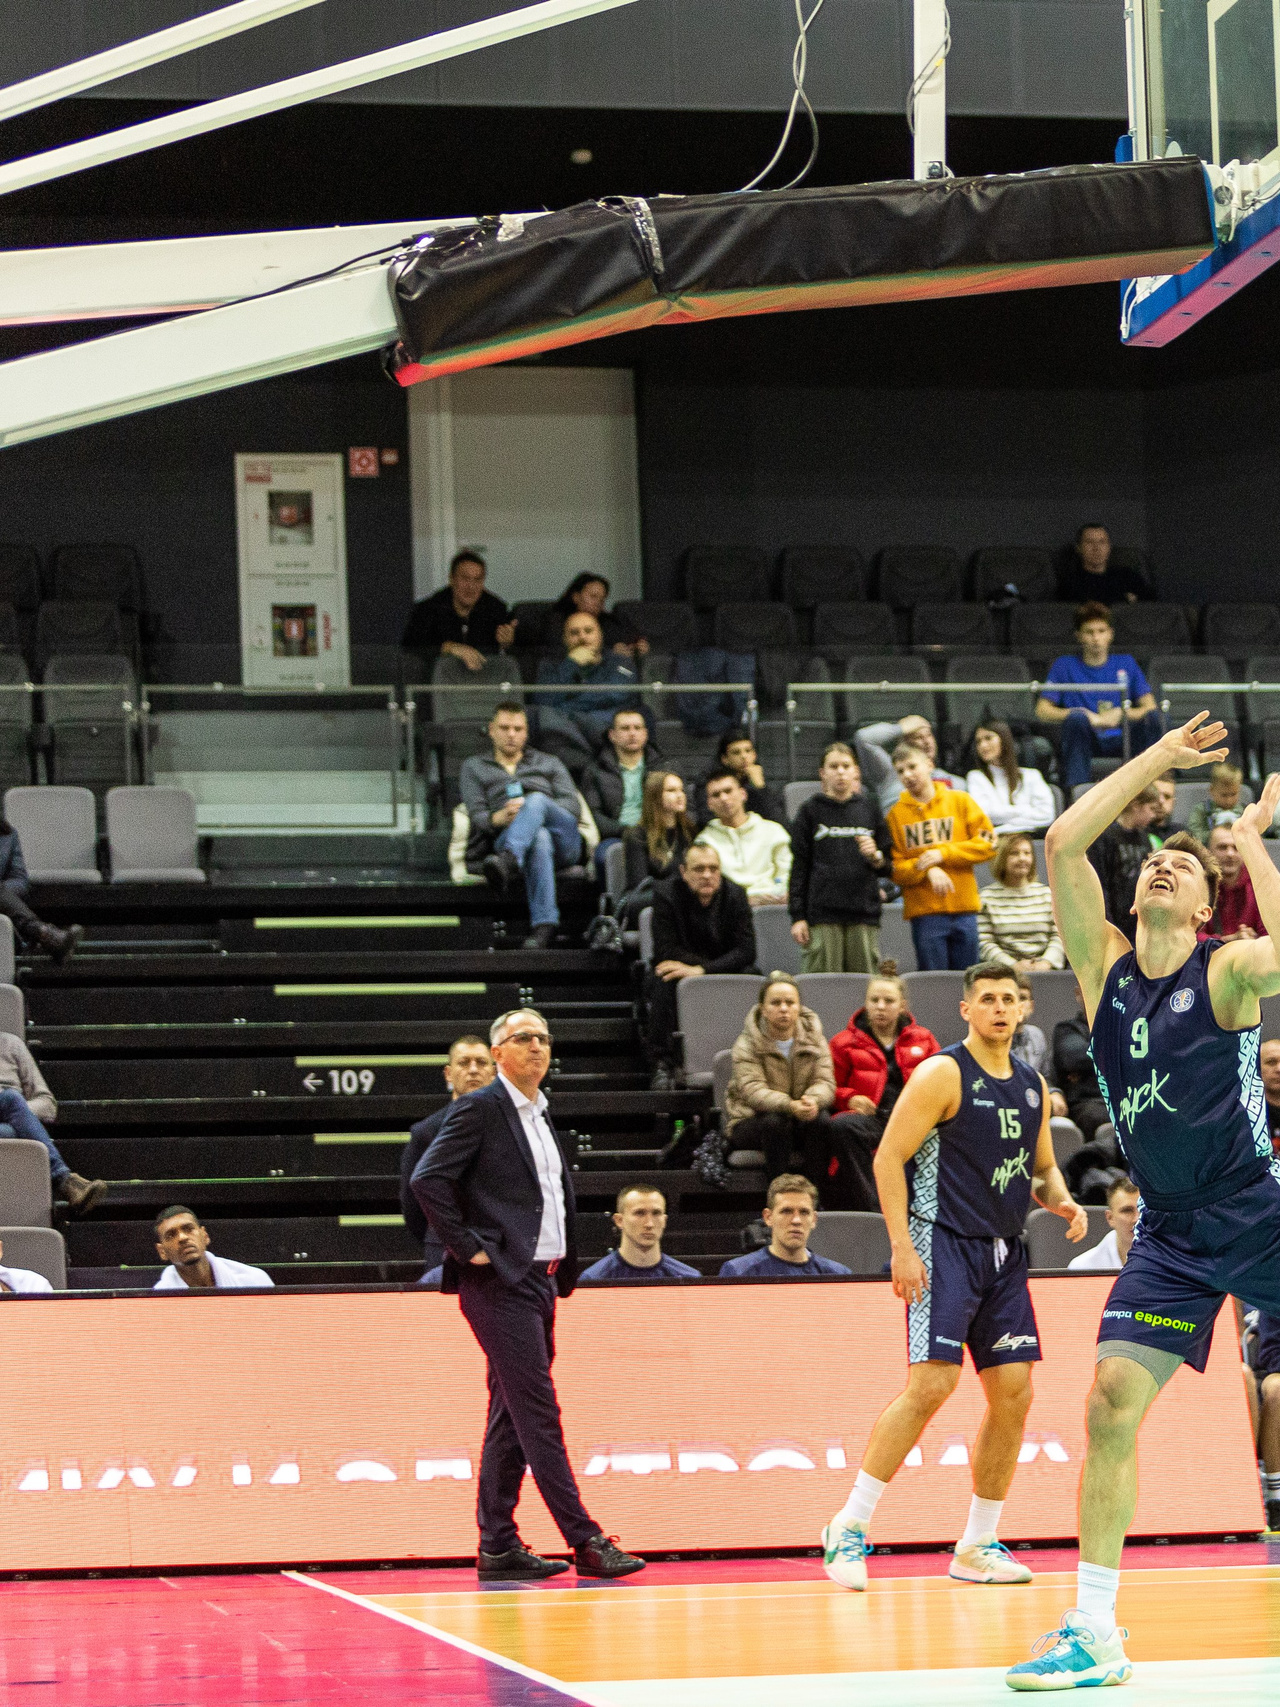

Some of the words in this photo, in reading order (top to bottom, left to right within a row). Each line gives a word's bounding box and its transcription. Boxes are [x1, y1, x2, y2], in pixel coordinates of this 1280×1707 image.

[904, 817, 954, 849] NEW
[1130, 1017, 1149, 1059] 9
[328, 1069, 375, 1095] 109
[998, 1108, 1022, 1139] 15
[1135, 1311, 1196, 1334] евроопт
